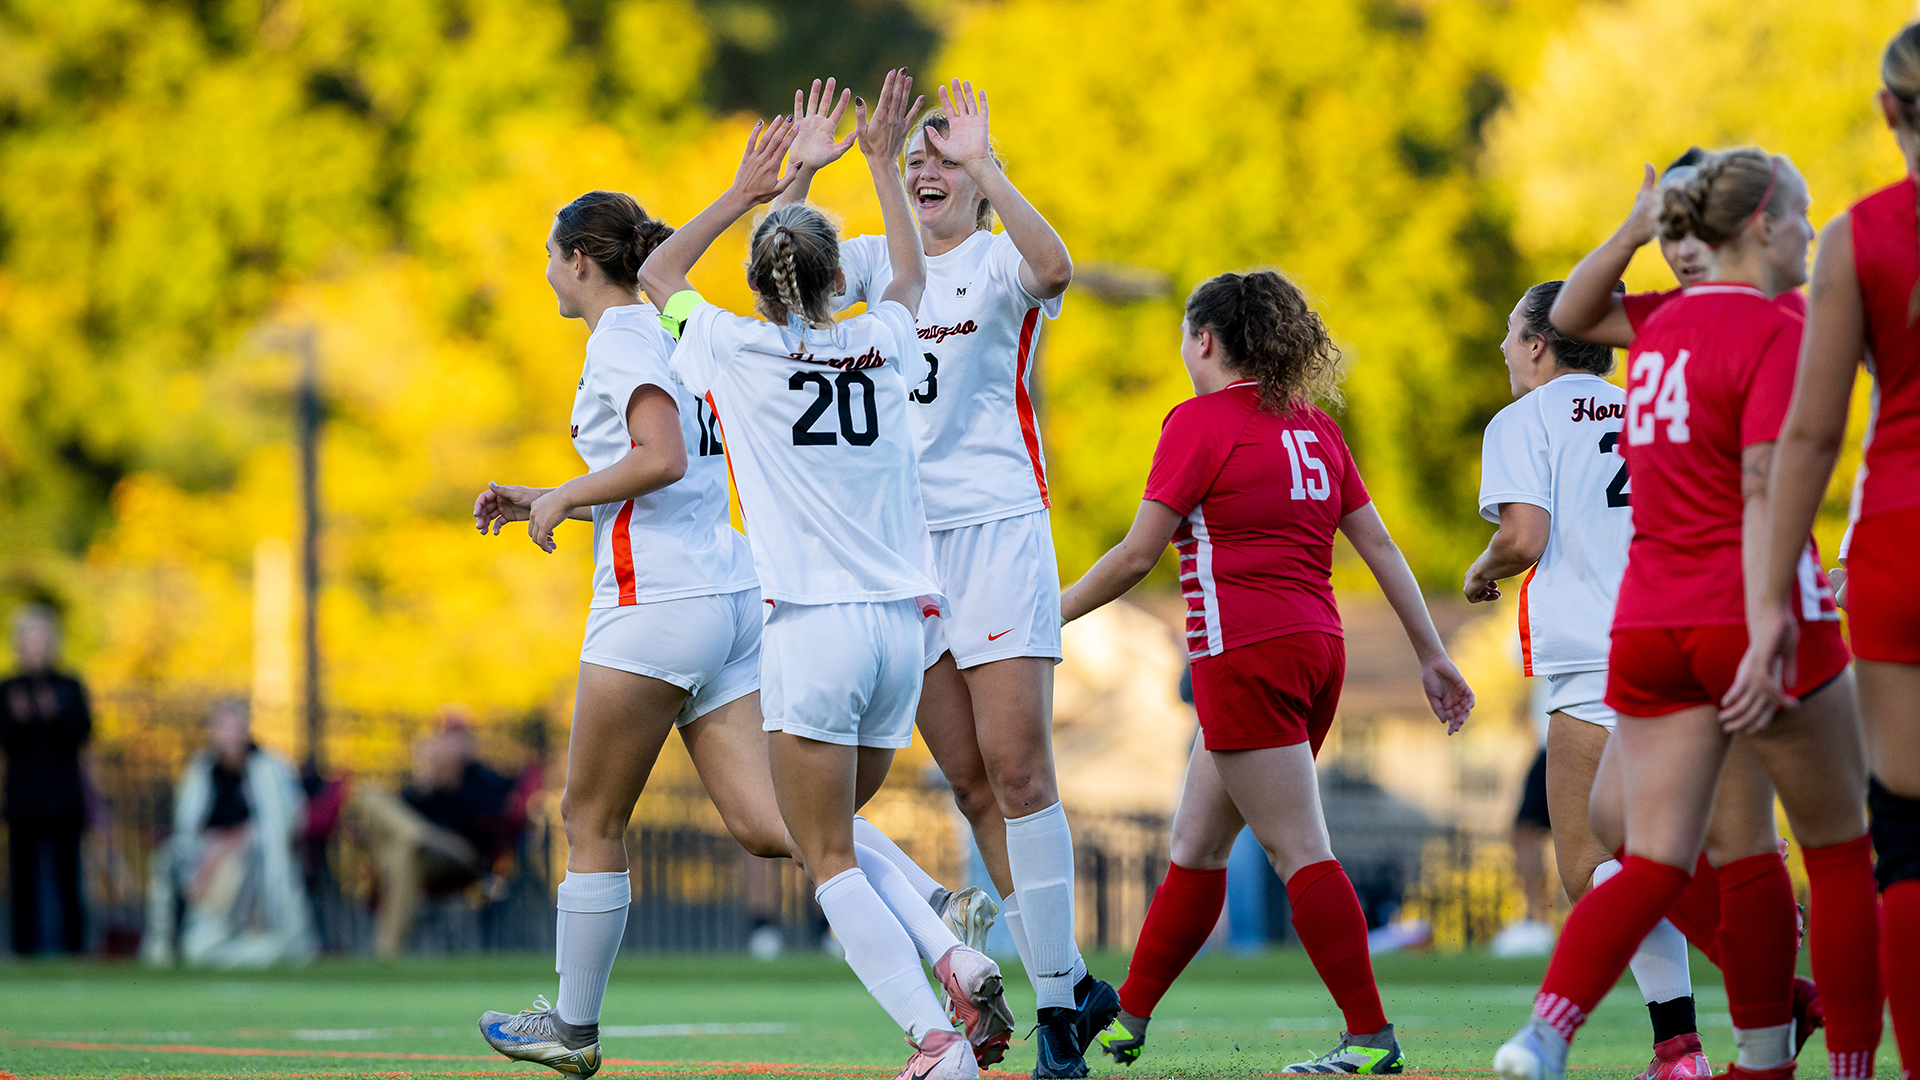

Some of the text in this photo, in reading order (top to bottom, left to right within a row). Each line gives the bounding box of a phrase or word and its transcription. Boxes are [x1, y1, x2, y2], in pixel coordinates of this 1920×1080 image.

[790, 346, 887, 372] Hrnets
[909, 352, 939, 404] 3
[788, 371, 879, 446] 20
[1627, 349, 1690, 447] 24
[1281, 429, 1331, 500] 15
